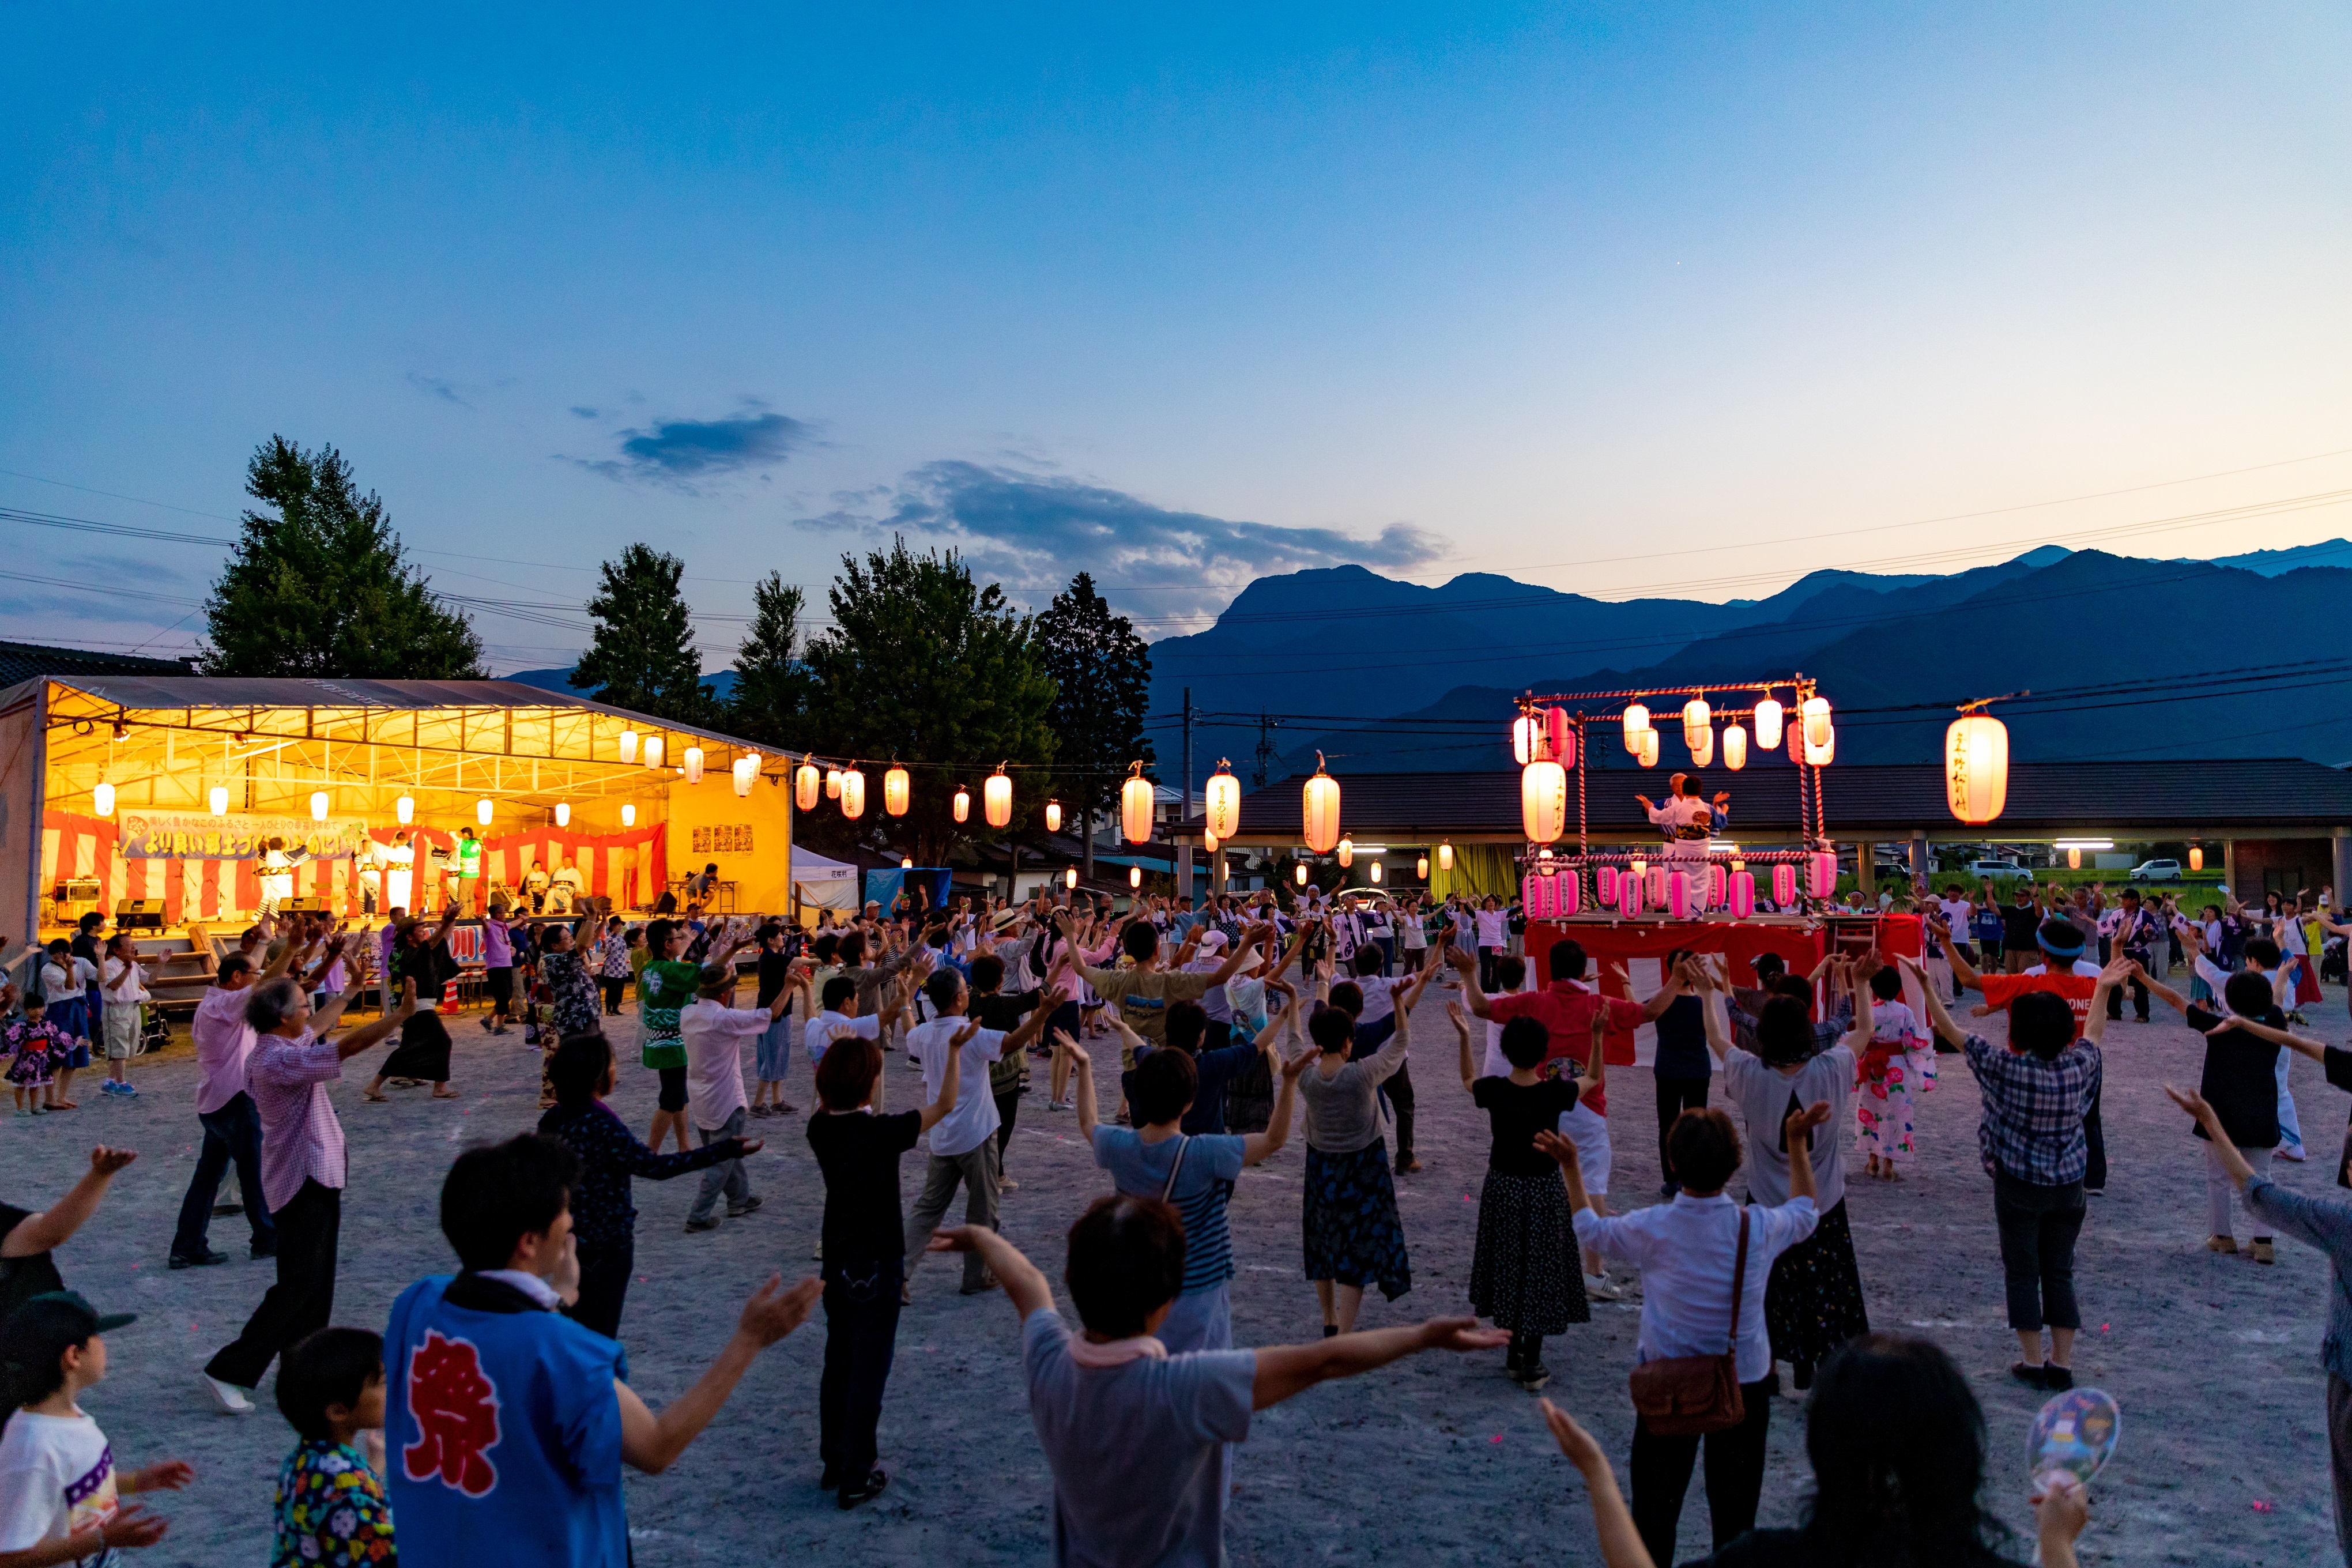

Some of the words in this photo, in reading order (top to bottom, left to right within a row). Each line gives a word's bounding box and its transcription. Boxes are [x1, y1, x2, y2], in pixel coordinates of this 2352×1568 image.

[149, 816, 249, 829] 美しく豊かなこのふるさと
[252, 820, 338, 830] 一人ひとりの幸福を求めて
[831, 870, 847, 878] 花咲村
[2066, 998, 2092, 1010] ONE
[403, 1327, 502, 1499] 祭
